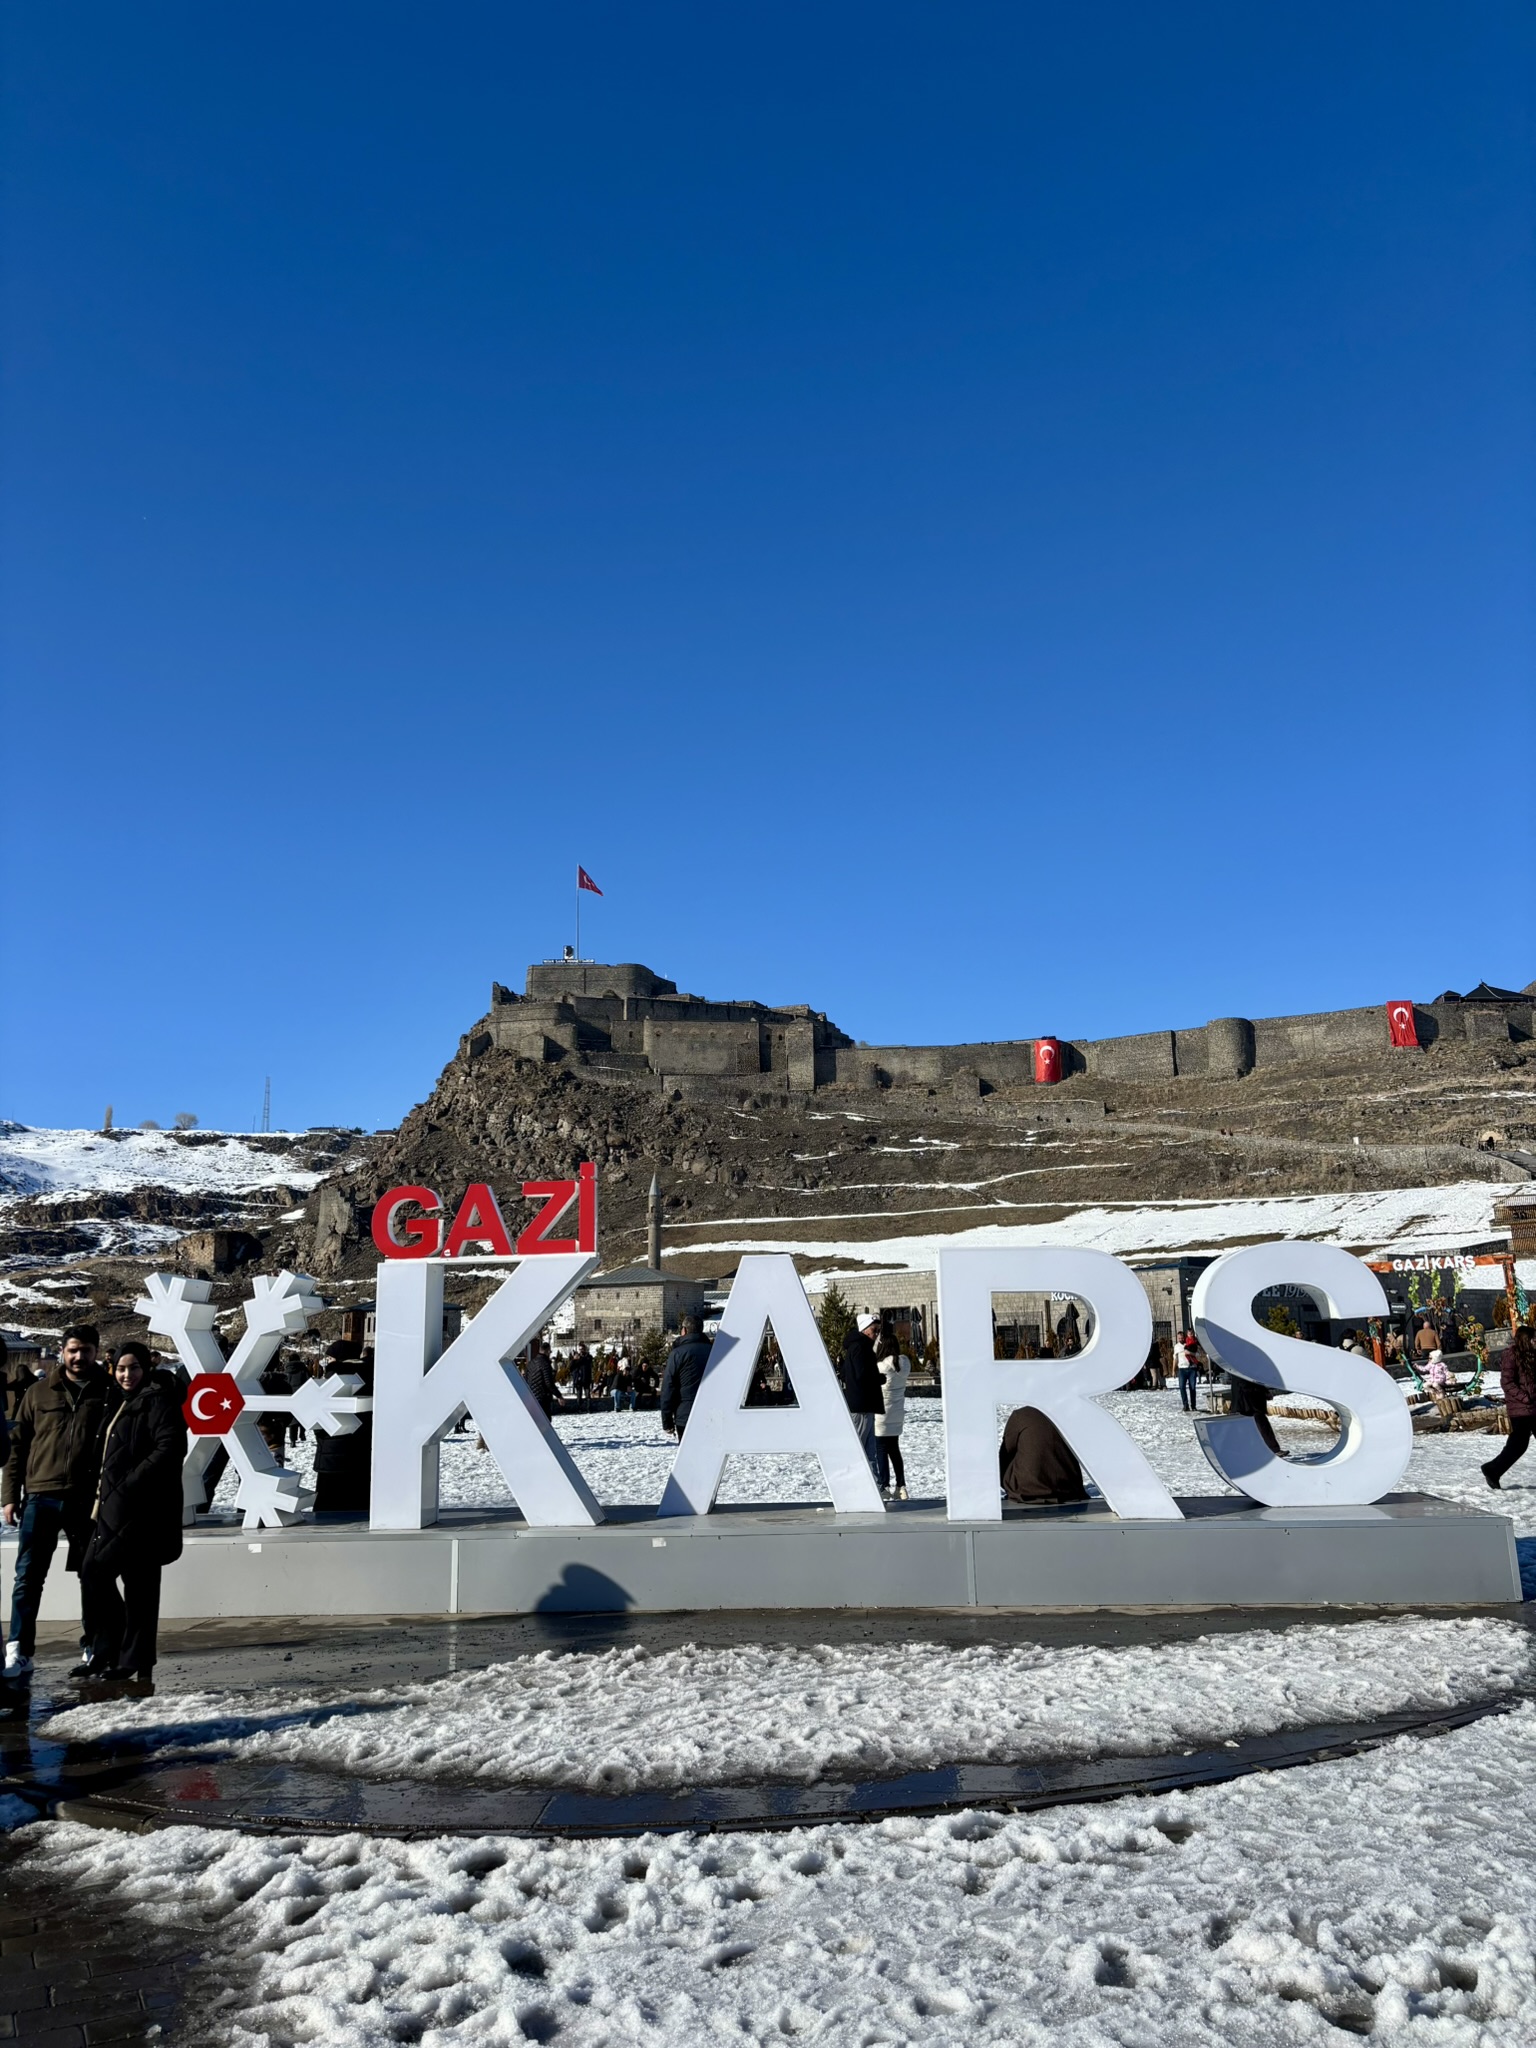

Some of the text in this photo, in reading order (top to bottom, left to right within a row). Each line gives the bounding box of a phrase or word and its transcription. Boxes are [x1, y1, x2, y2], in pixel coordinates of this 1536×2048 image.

[371, 1162, 597, 1259] GAZİ
[1431, 1255, 1476, 1270] KARS
[369, 1240, 1414, 1530] KARS
